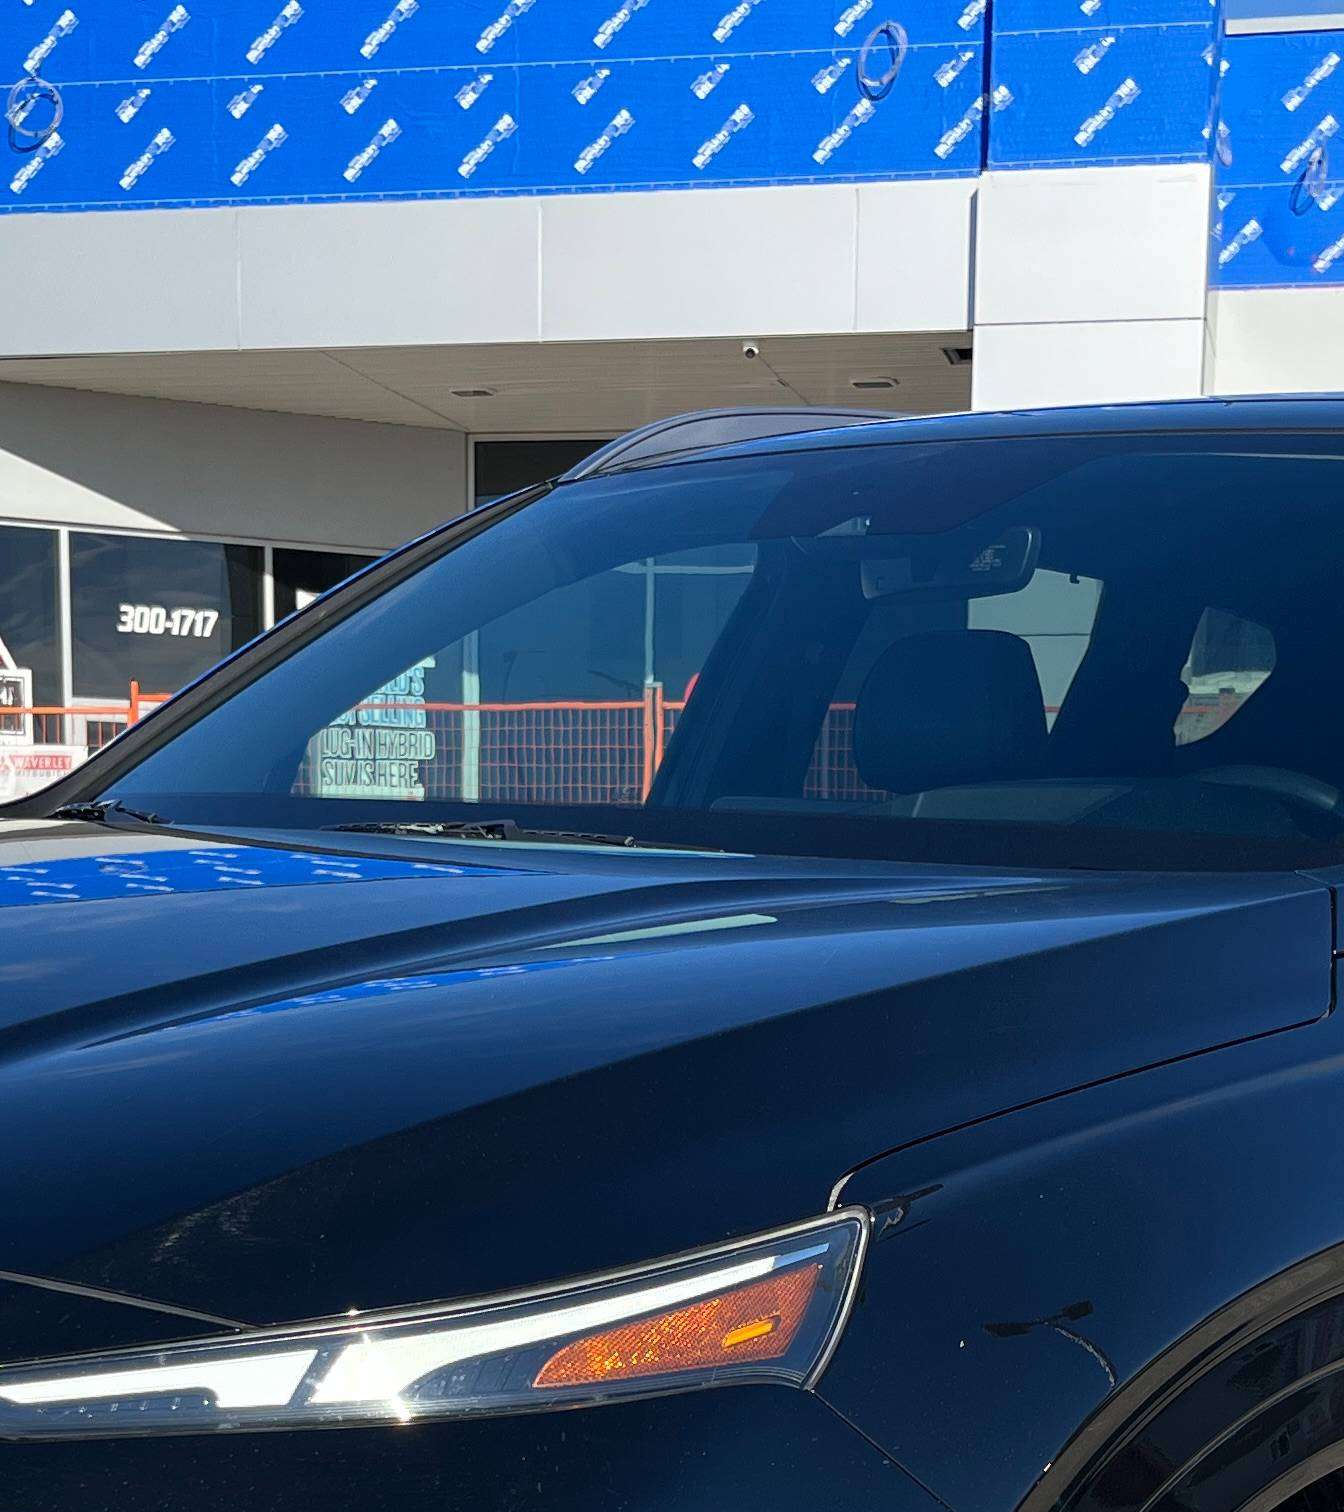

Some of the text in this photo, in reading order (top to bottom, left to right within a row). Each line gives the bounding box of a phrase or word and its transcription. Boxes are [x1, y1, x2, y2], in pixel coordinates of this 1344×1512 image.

[117, 603, 219, 638] 300-1717
[376, 730, 435, 759] HYBRID
[14, 757, 71, 769] WAVERLEY
[375, 761, 421, 788] HERE
